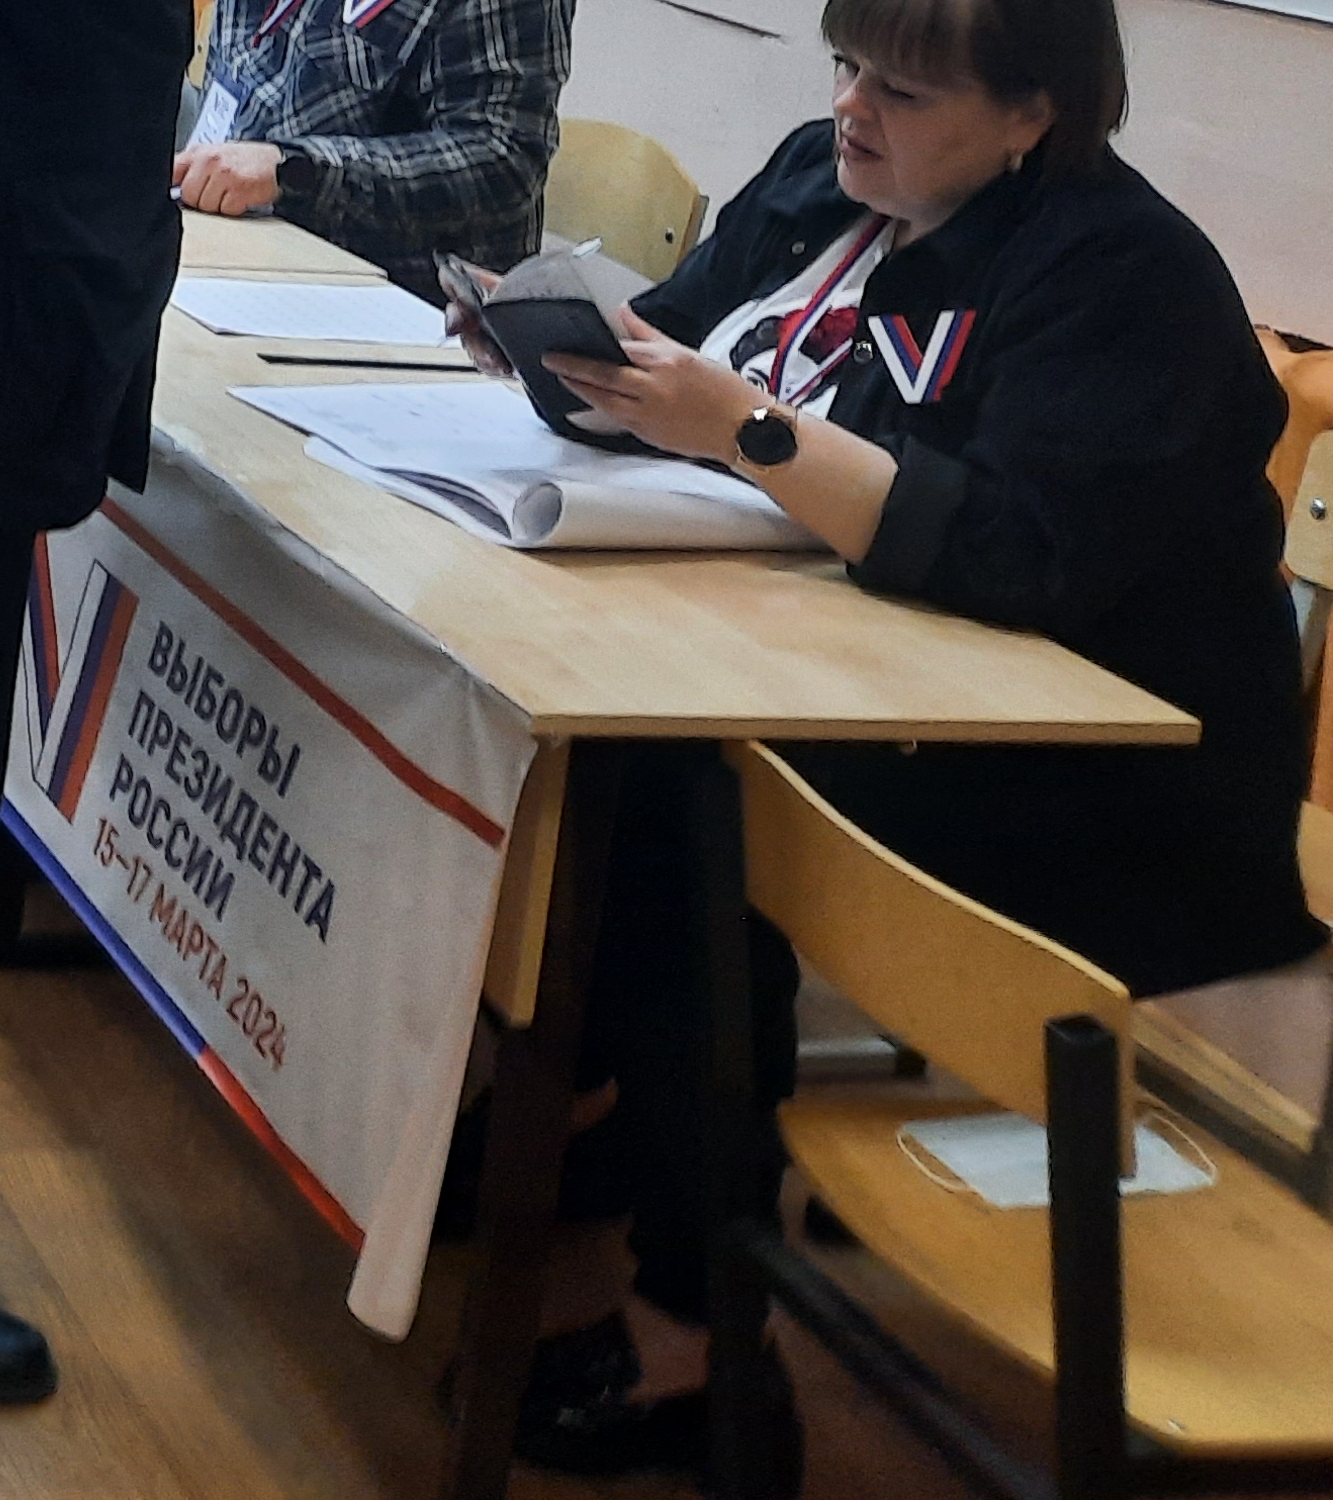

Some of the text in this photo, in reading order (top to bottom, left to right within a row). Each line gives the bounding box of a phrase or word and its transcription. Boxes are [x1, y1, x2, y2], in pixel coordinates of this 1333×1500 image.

[146, 620, 301, 800] ВЫБОРЫ
[109, 754, 235, 923] РОССИИ
[127, 690, 337, 943] ПРЕЗИДЕНТА
[148, 886, 226, 1000] МАРТА
[225, 976, 288, 1072] 2024
